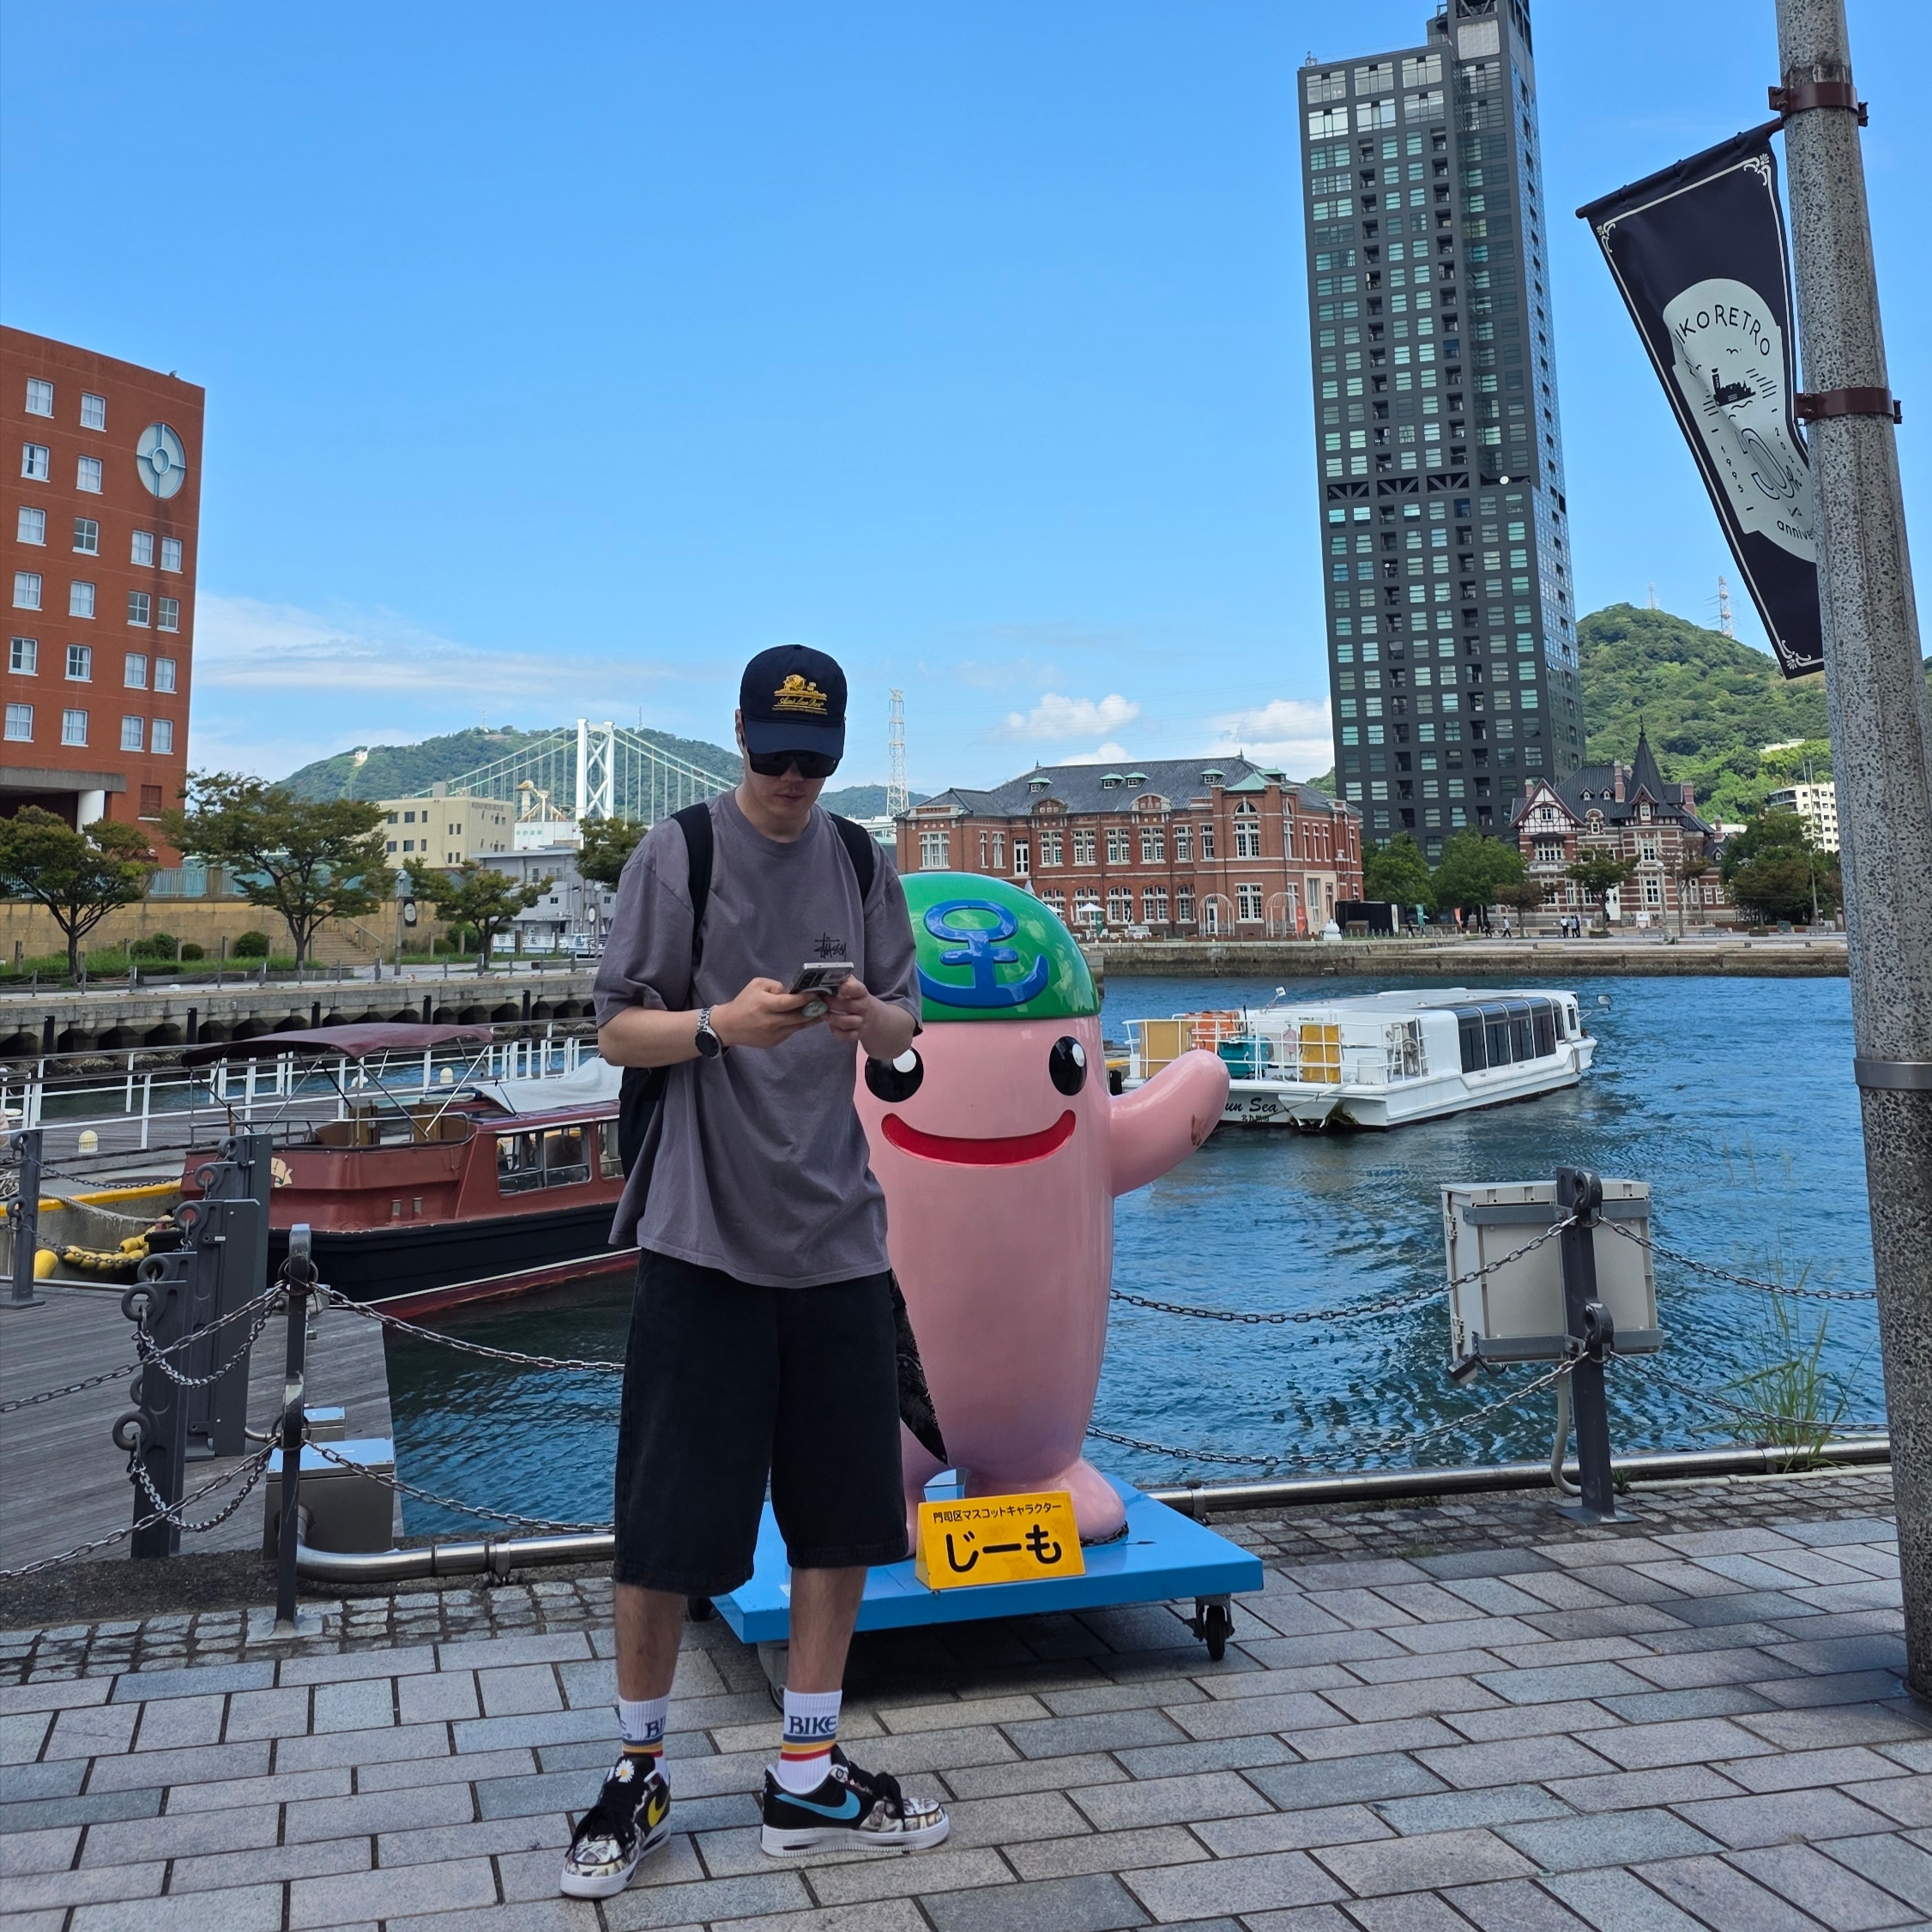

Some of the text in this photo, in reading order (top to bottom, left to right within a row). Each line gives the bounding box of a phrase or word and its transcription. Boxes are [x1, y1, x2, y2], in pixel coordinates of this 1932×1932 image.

[1675, 305, 1770, 355] IKORETRO
[1721, 445, 1744, 492] 1995
[1777, 520, 1814, 540] annive
[1224, 1097, 1278, 1113] un Sea
[933, 1502, 1062, 1524] 門司区マスコットキャラクター
[945, 1524, 1062, 1573] じーも
[644, 1715, 666, 1738] BI
[788, 1715, 837, 1735] BIKE
